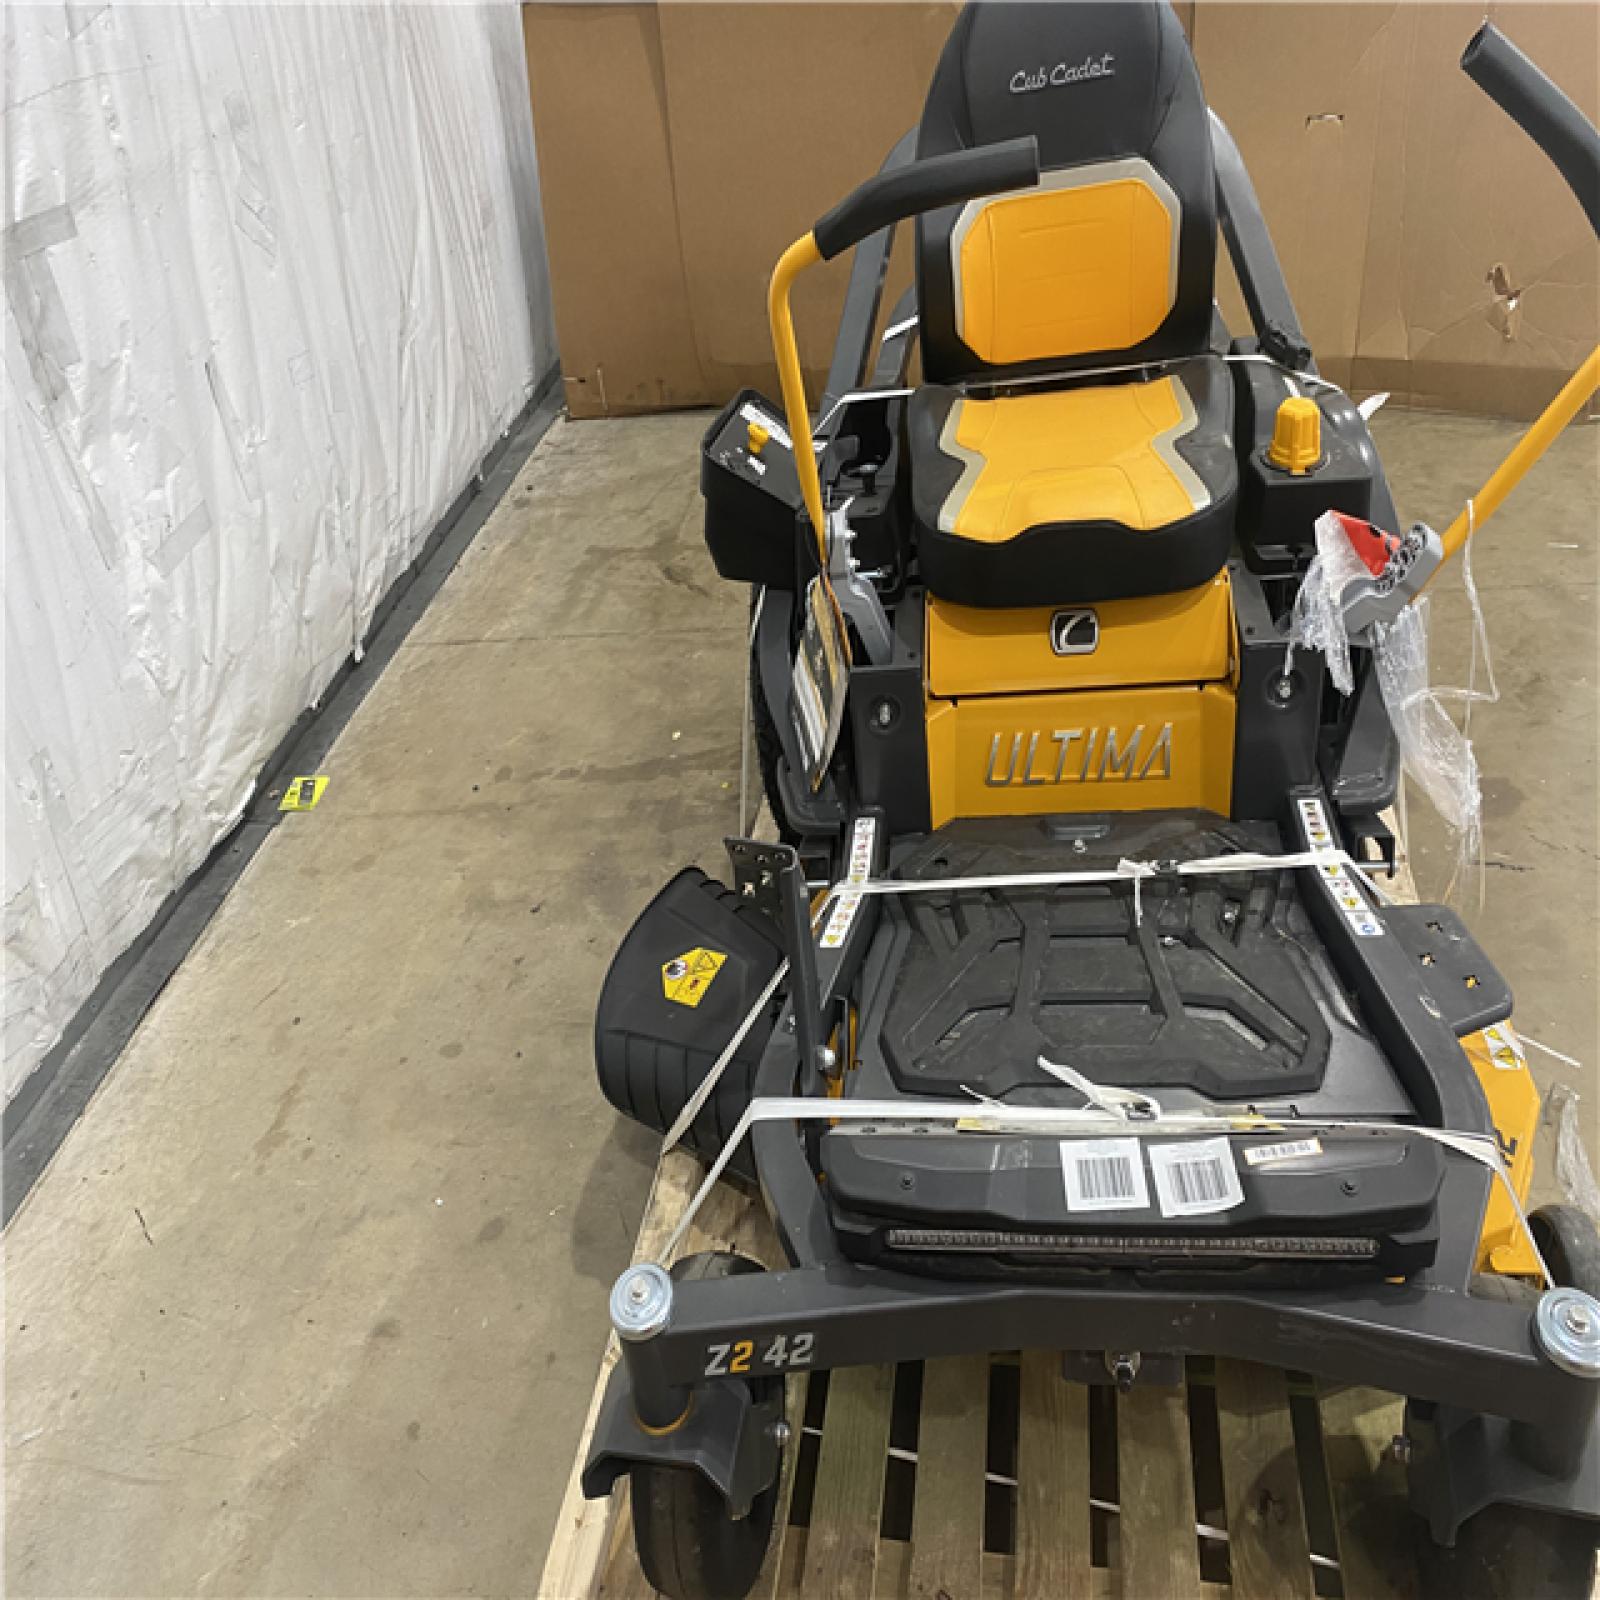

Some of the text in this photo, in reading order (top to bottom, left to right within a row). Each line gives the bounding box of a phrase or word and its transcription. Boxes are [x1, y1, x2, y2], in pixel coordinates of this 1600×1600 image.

[1009, 53, 1115, 93] Cub Cadet
[985, 721, 1173, 787] ULTIMA
[704, 1332, 814, 1377] Z2 42
